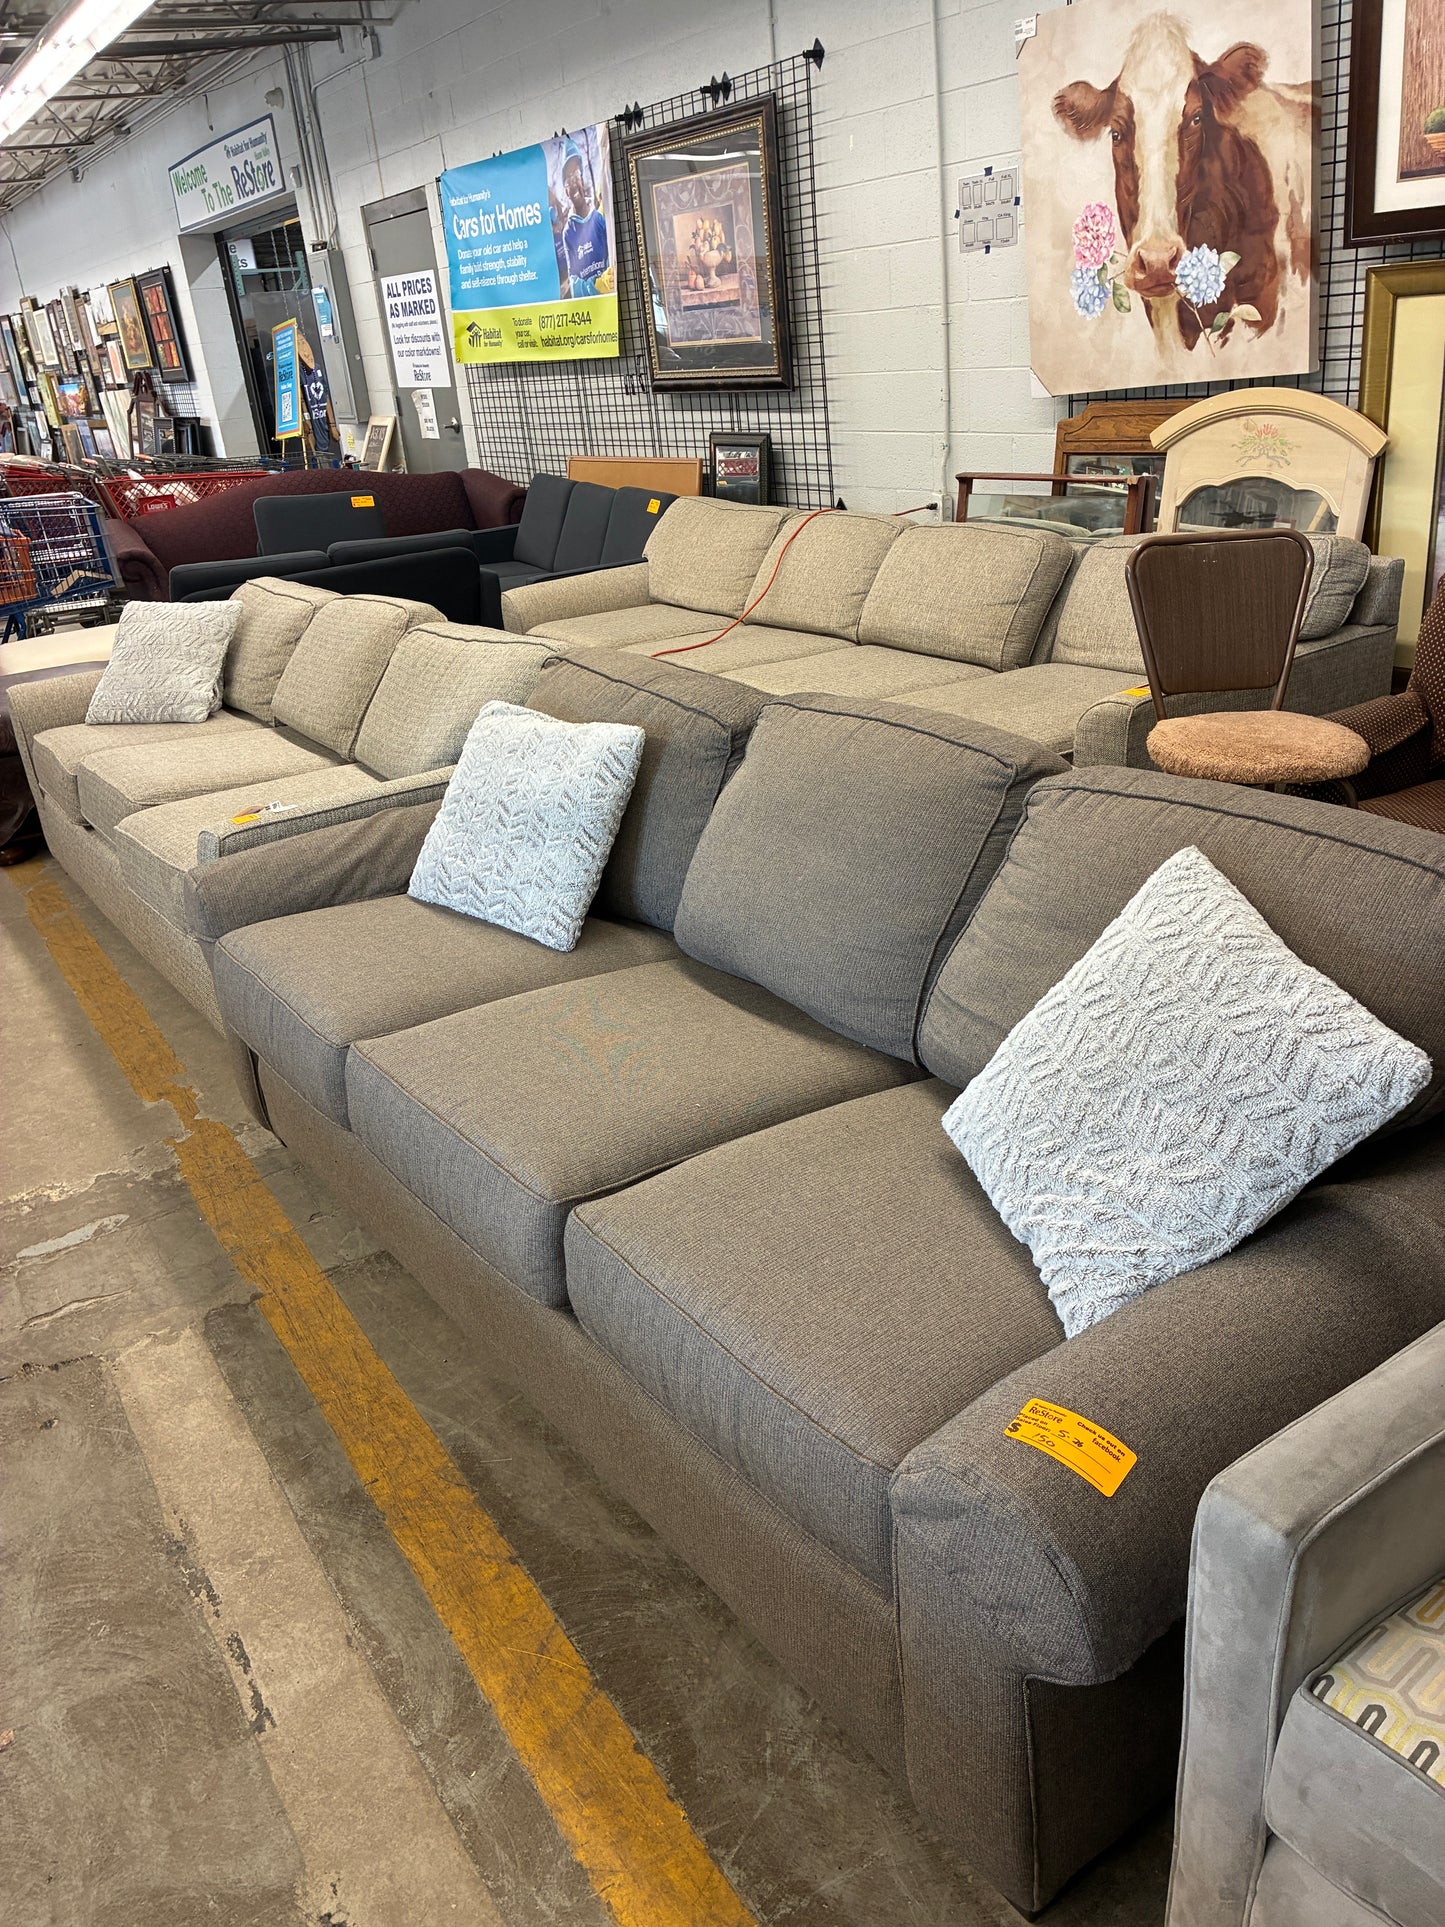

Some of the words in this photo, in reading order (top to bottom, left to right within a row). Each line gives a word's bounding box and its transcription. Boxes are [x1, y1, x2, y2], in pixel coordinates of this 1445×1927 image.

[172, 164, 208, 196] Welcome
[201, 188, 216, 213] To
[212, 181, 234, 209] The
[230, 159, 276, 200] ReStore
[453, 214, 479, 240] Cars
[479, 208, 496, 236] for
[496, 202, 542, 232] Homes
[483, 244, 492, 255] old
[493, 245, 502, 254] car
[502, 240, 512, 252] and
[512, 238, 524, 251] help
[524, 240, 528, 249] a
[460, 263, 474, 275] family
[482, 258, 506, 271] strength,
[507, 255, 527, 268] stability
[386, 282, 401, 299] ALL
[402, 277, 432, 296] PRICES
[461, 279, 471, 289] and
[496, 274, 518, 285] through
[519, 270, 538, 282] shelter.
[390, 303, 400, 318] AS
[401, 298, 436, 317] MARKED
[512, 318, 519, 326] To
[519, 317, 532, 326] donate
[539, 314, 555, 331] (877)
[556, 311, 592, 327] 277-4344
[394, 335, 404, 344] Look
[411, 333, 431, 343] discounts
[431, 332, 441, 341] with
[483, 328, 502, 339] Habitat
[540, 331, 618, 348] habitat.org/carsforhomes
[405, 347, 415, 357] color
[416, 346, 441, 356] markdowns!
[414, 369, 431, 381] ReStore
[1016, 1417, 1031, 1425] Sales
[1029, 1406, 1062, 1424] ReStore
[1008, 1422, 1022, 1433] $
[1032, 1433, 1055, 1447] 150
[1077, 1422, 1096, 1435] Check
[1106, 1440, 1117, 1449] out
[1092, 1438, 1120, 1462] facebook
